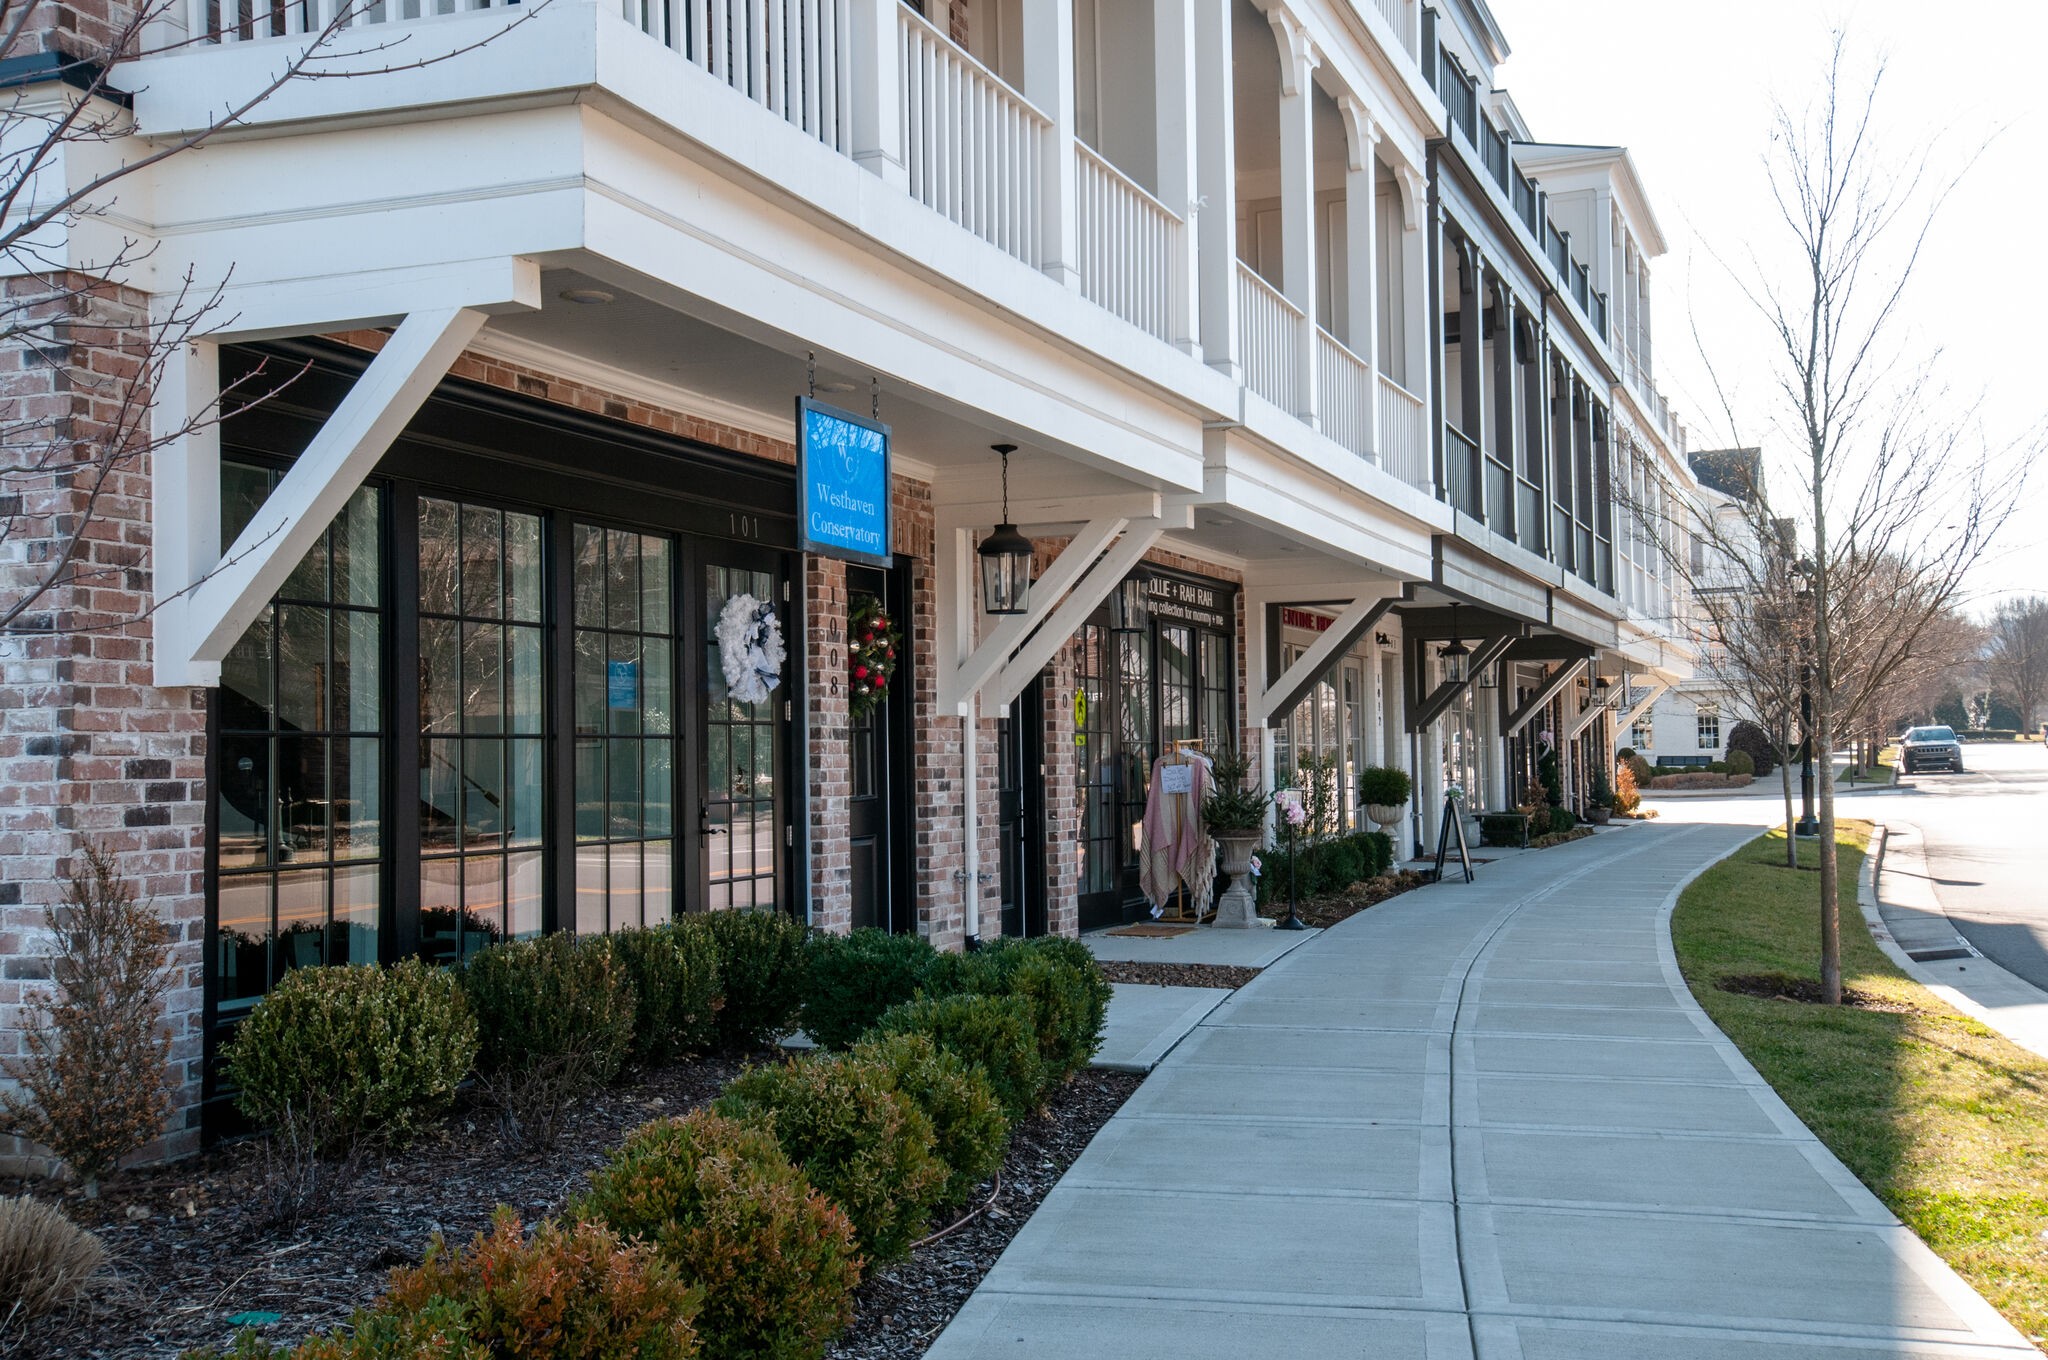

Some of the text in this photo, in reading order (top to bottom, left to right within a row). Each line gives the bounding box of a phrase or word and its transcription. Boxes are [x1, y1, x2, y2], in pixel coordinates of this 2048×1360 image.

[816, 482, 876, 517] Westhaven
[729, 513, 759, 539] 101
[811, 511, 881, 548] Conservatory
[1149, 578, 1170, 598] OLLIE
[1179, 585, 1196, 604] RAH
[1197, 589, 1213, 608] RAH
[1148, 599, 1158, 616] ing
[1159, 602, 1184, 618] collection
[1193, 610, 1212, 627] mommy
[1216, 615, 1224, 626] me
[1283, 608, 1315, 630] ENTINE
